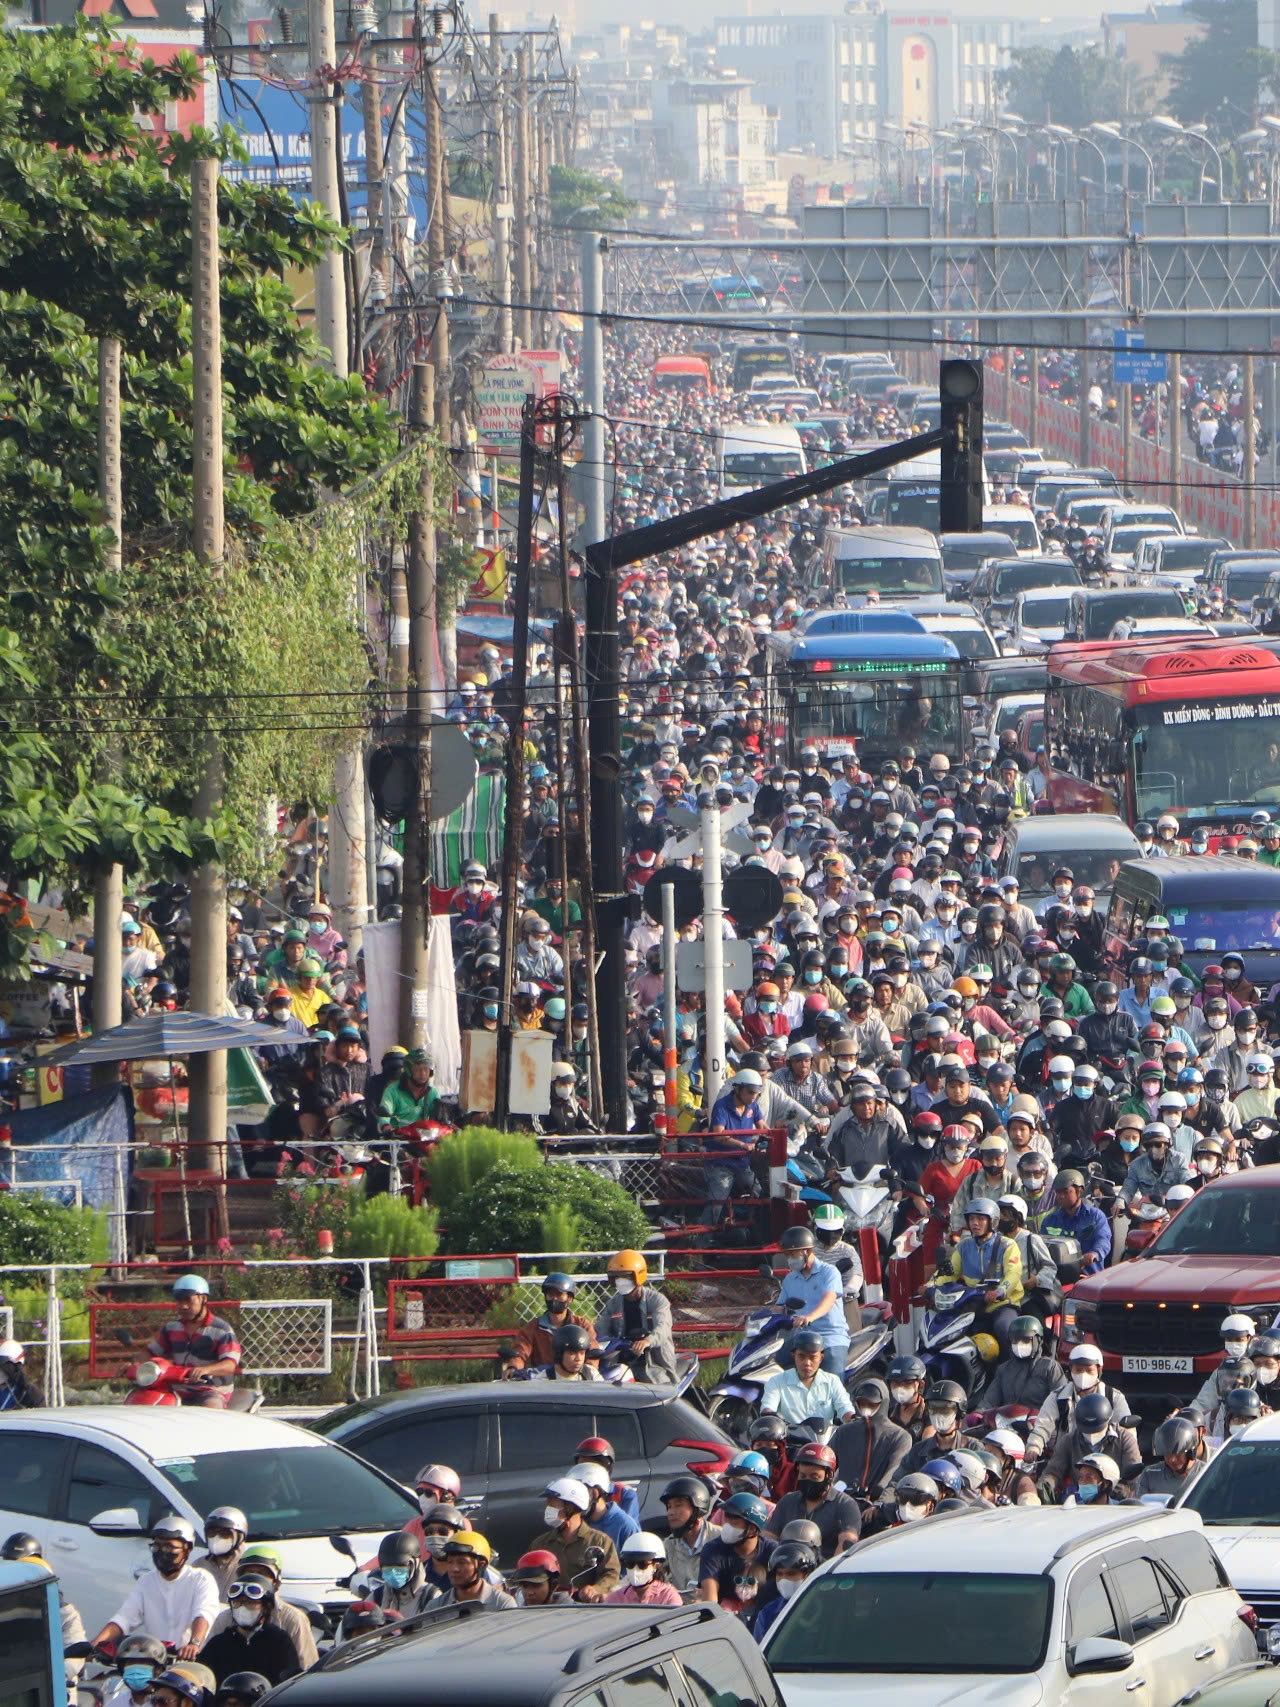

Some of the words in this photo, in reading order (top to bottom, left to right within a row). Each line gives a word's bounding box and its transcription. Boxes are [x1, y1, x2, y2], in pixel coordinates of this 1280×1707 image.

[1215, 704, 1231, 720] BÌNH
[712, 1058, 720, 1072] D
[1128, 1360, 1187, 1371] 51D-986.42
